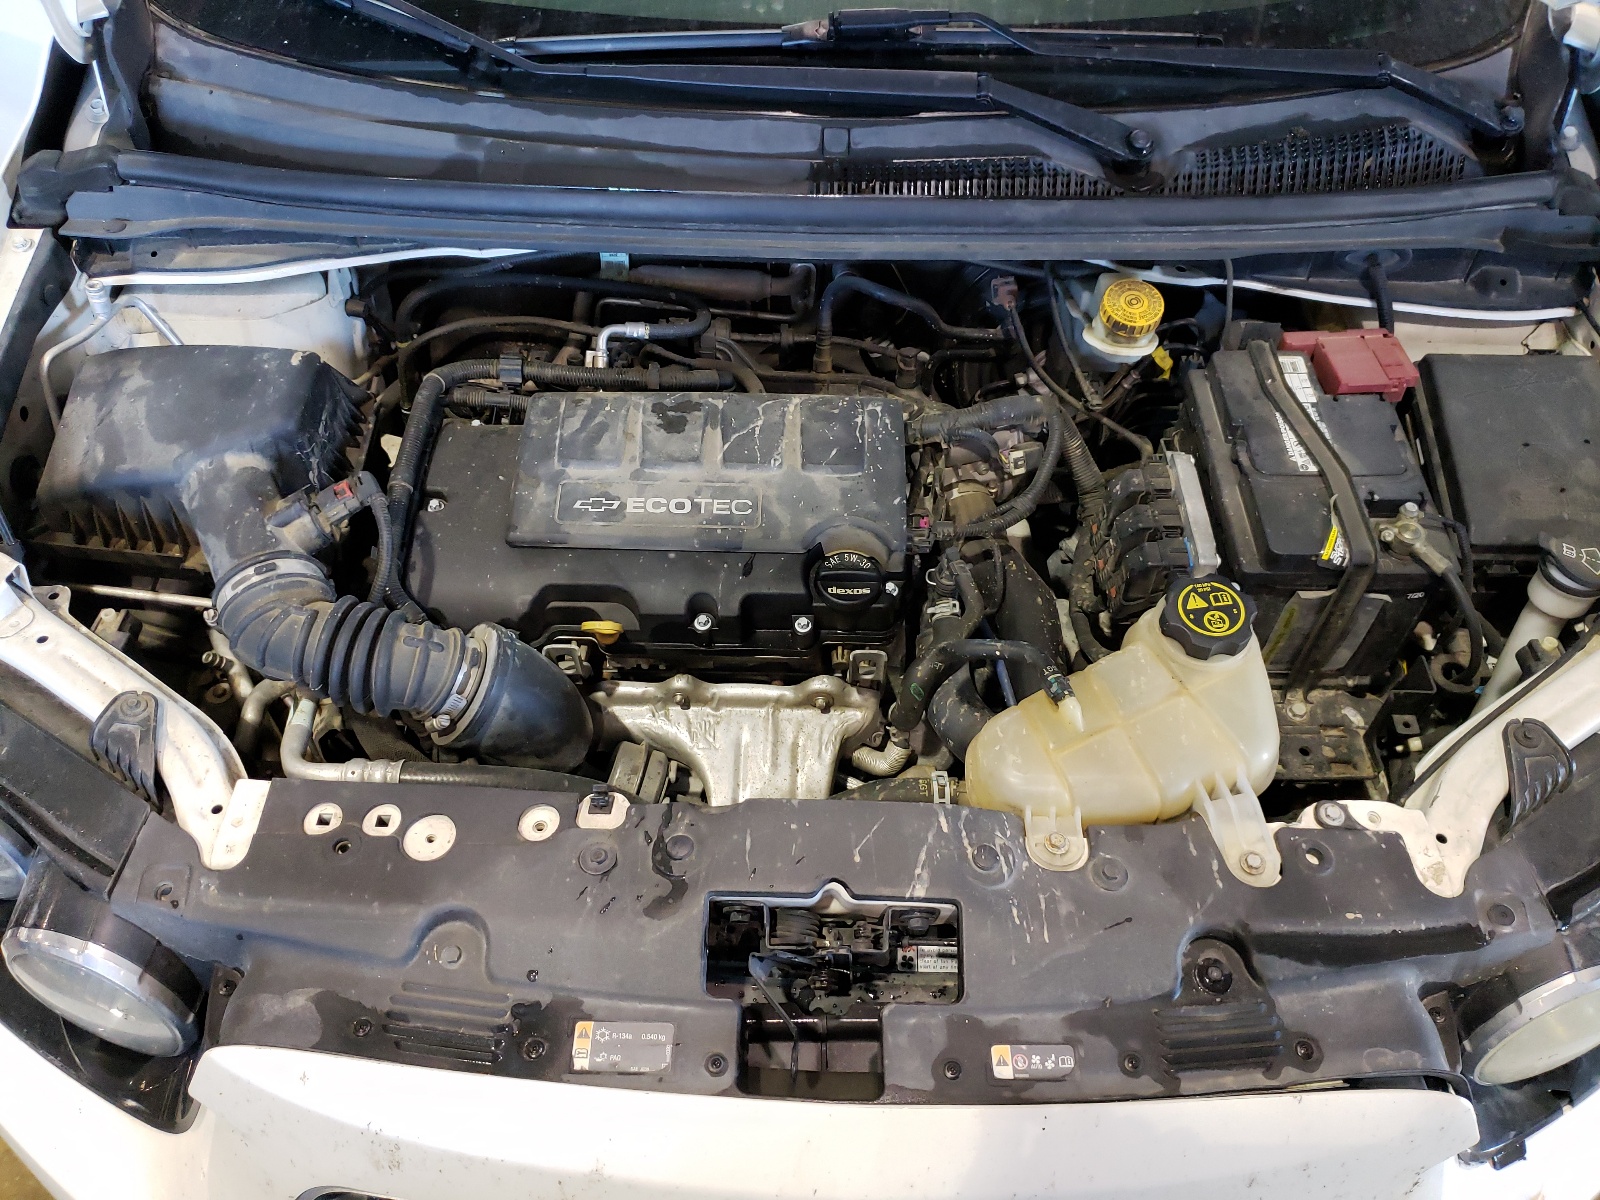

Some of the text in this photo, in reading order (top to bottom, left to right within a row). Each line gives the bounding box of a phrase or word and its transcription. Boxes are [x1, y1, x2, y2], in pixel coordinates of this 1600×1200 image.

[626, 497, 753, 515] ECOTEC
[825, 554, 871, 568] SAE 5W-30
[828, 586, 870, 594] dexos
[658, 1033, 666, 1042] kg
